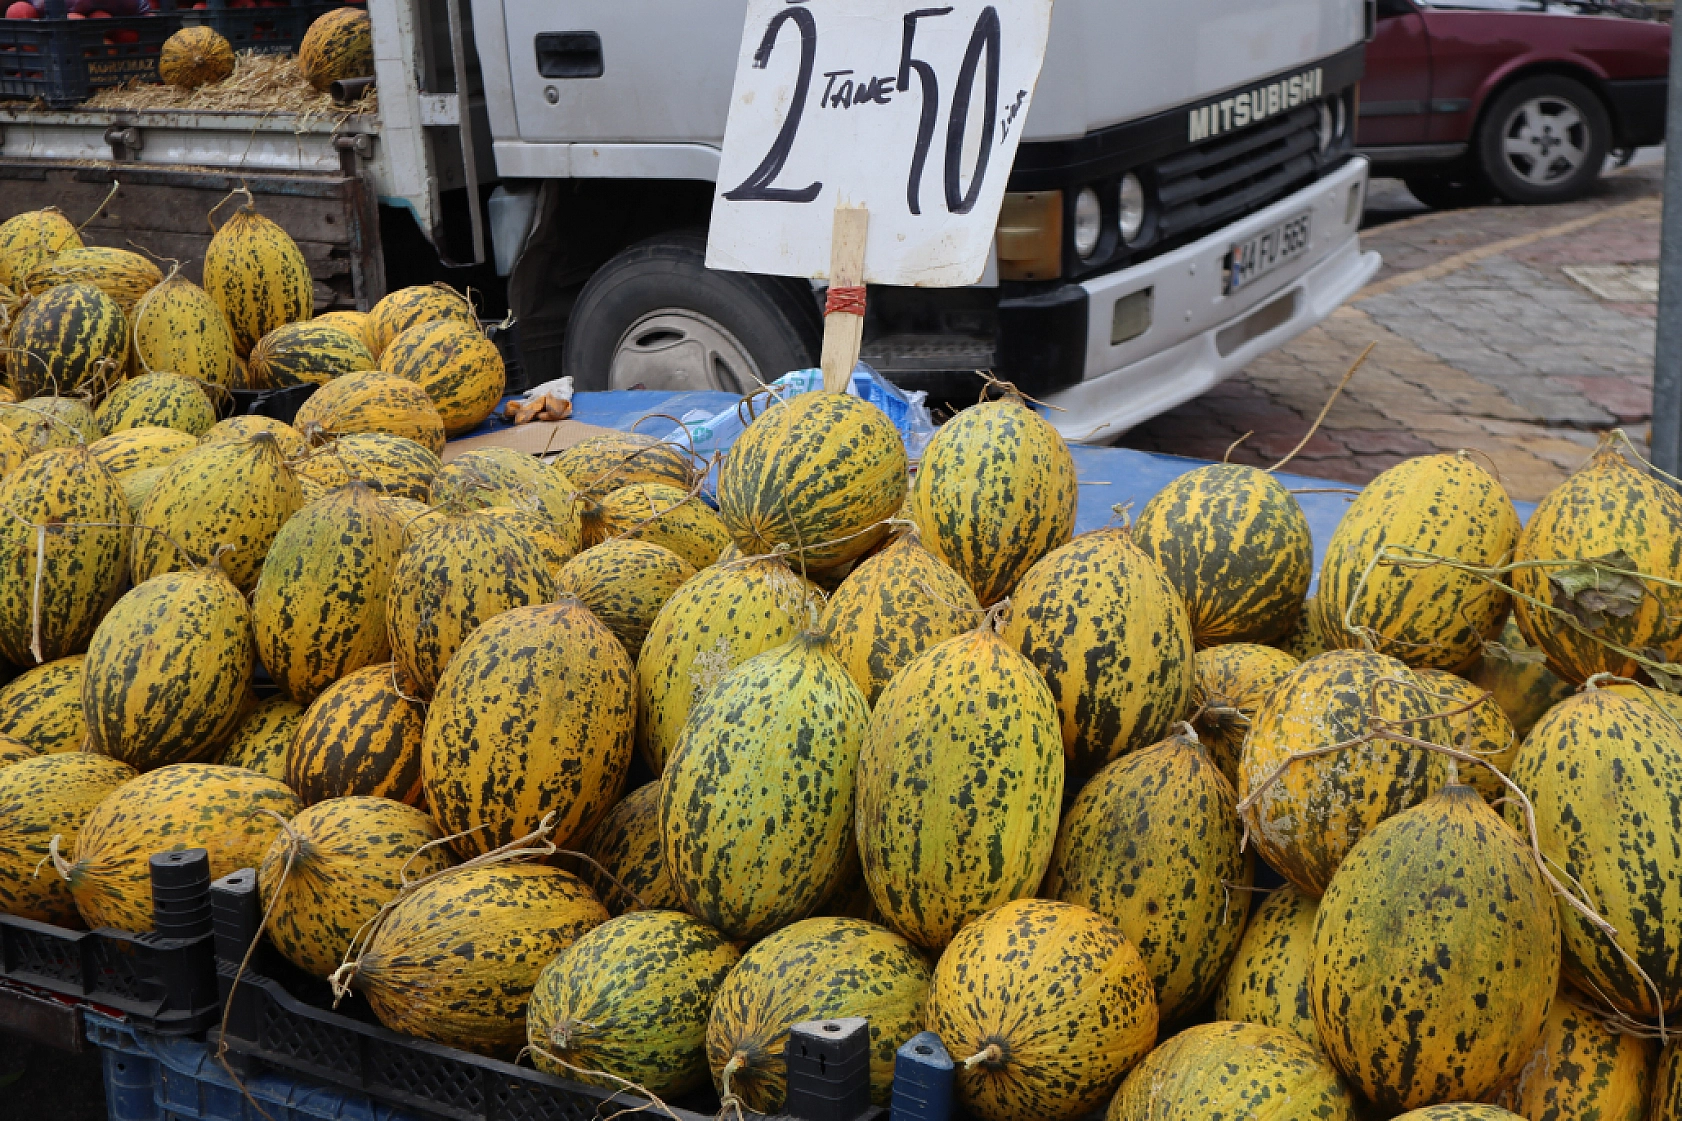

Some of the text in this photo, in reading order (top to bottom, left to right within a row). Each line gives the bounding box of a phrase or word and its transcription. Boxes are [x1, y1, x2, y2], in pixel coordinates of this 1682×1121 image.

[721, 6, 823, 203] 2
[821, 69, 897, 109] TANE
[897, 5, 1000, 215] 50
[1188, 67, 1323, 143] MITSUBISHI
